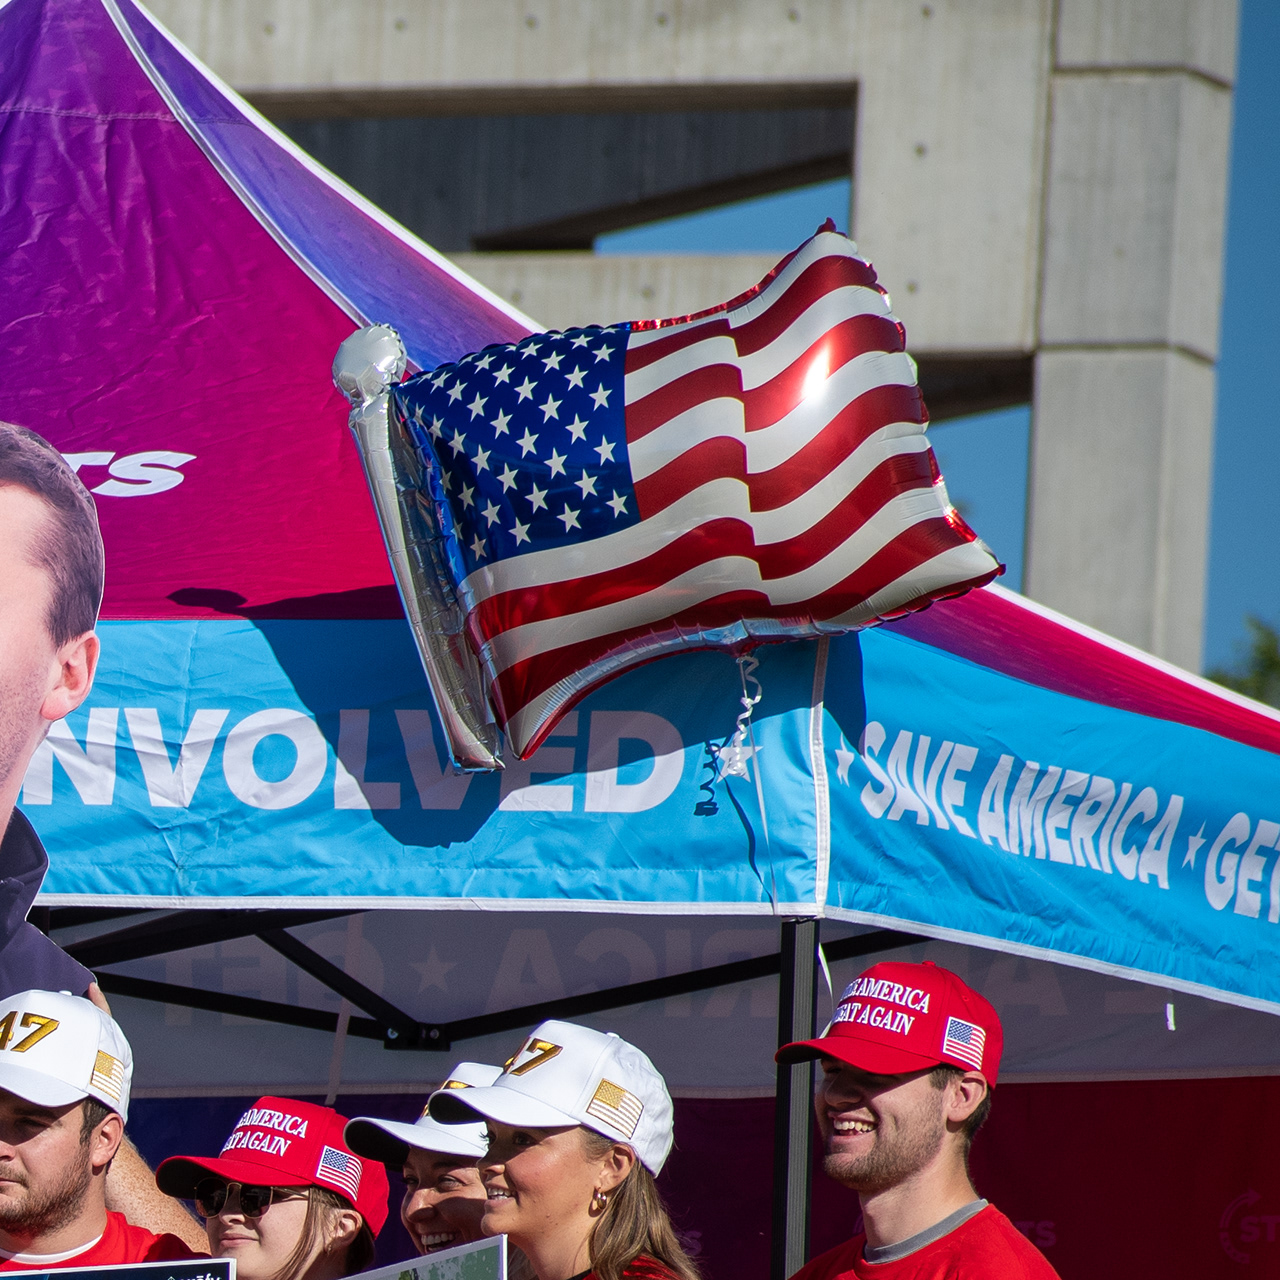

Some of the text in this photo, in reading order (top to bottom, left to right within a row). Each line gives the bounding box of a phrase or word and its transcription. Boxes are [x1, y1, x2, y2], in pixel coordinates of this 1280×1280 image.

[859, 720, 979, 840] SAVE
[976, 753, 1185, 890] AMERICA
[856, 977, 930, 1014] AMERICA
[857, 1004, 915, 1036] AGAIN
[236, 1131, 291, 1157] AGAIN
